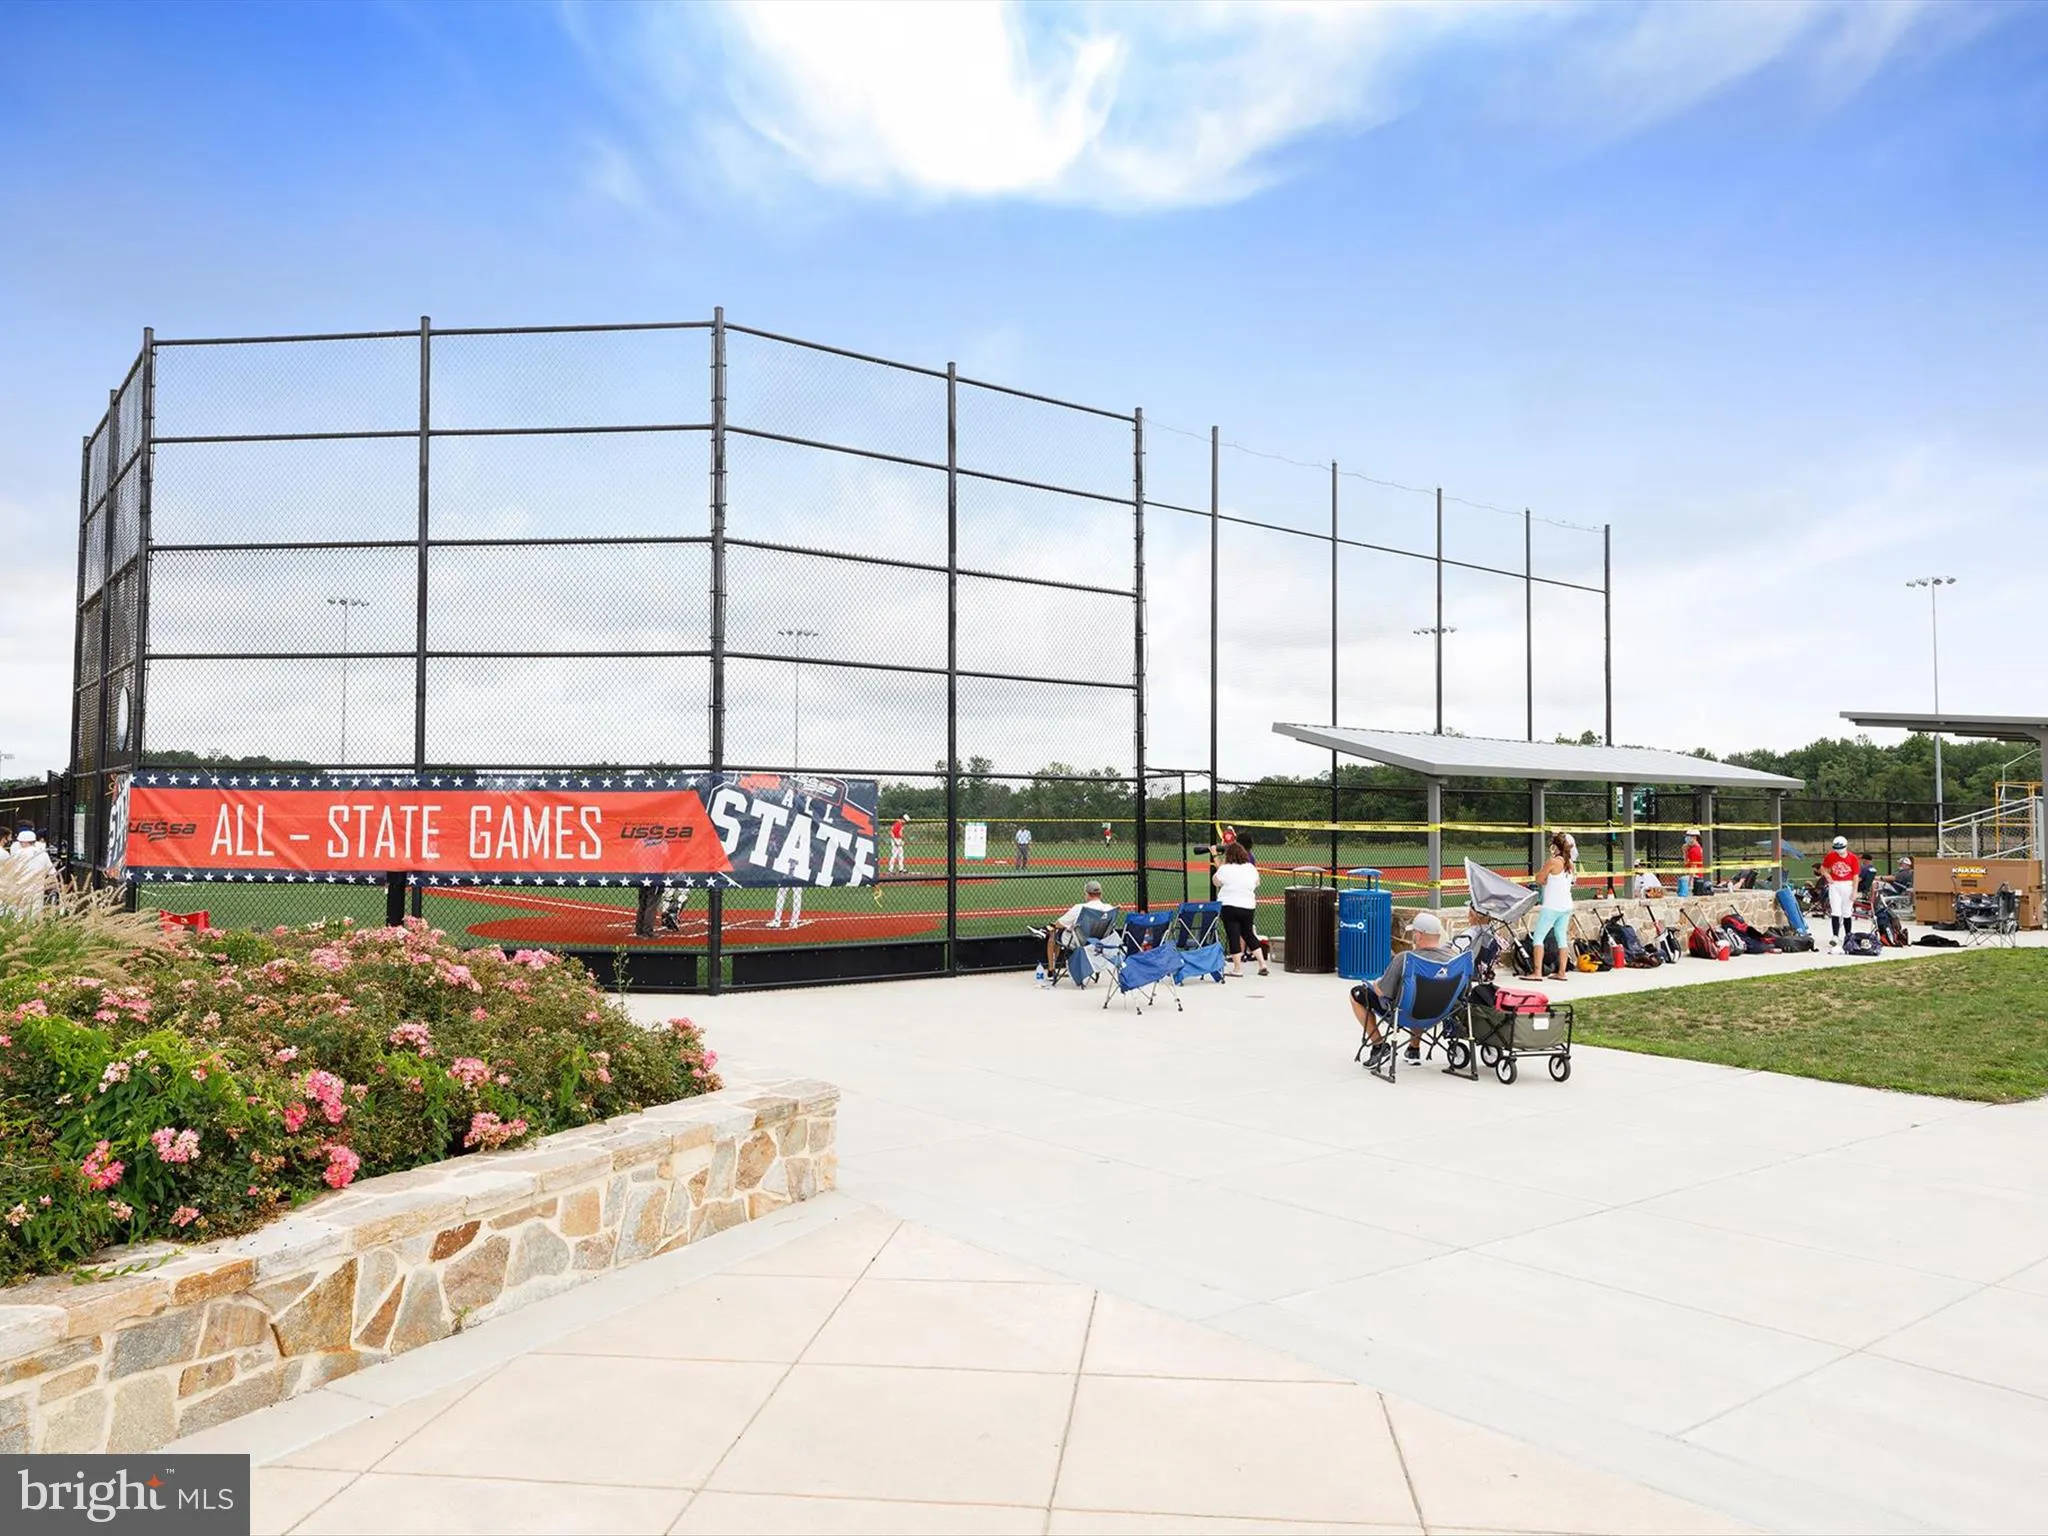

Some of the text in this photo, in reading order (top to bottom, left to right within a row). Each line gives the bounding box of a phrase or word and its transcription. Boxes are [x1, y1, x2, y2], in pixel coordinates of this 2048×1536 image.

[210, 803, 275, 857] ALL
[327, 804, 441, 859] STATE
[469, 804, 602, 860] GAMES
[710, 788, 875, 887] STATE
